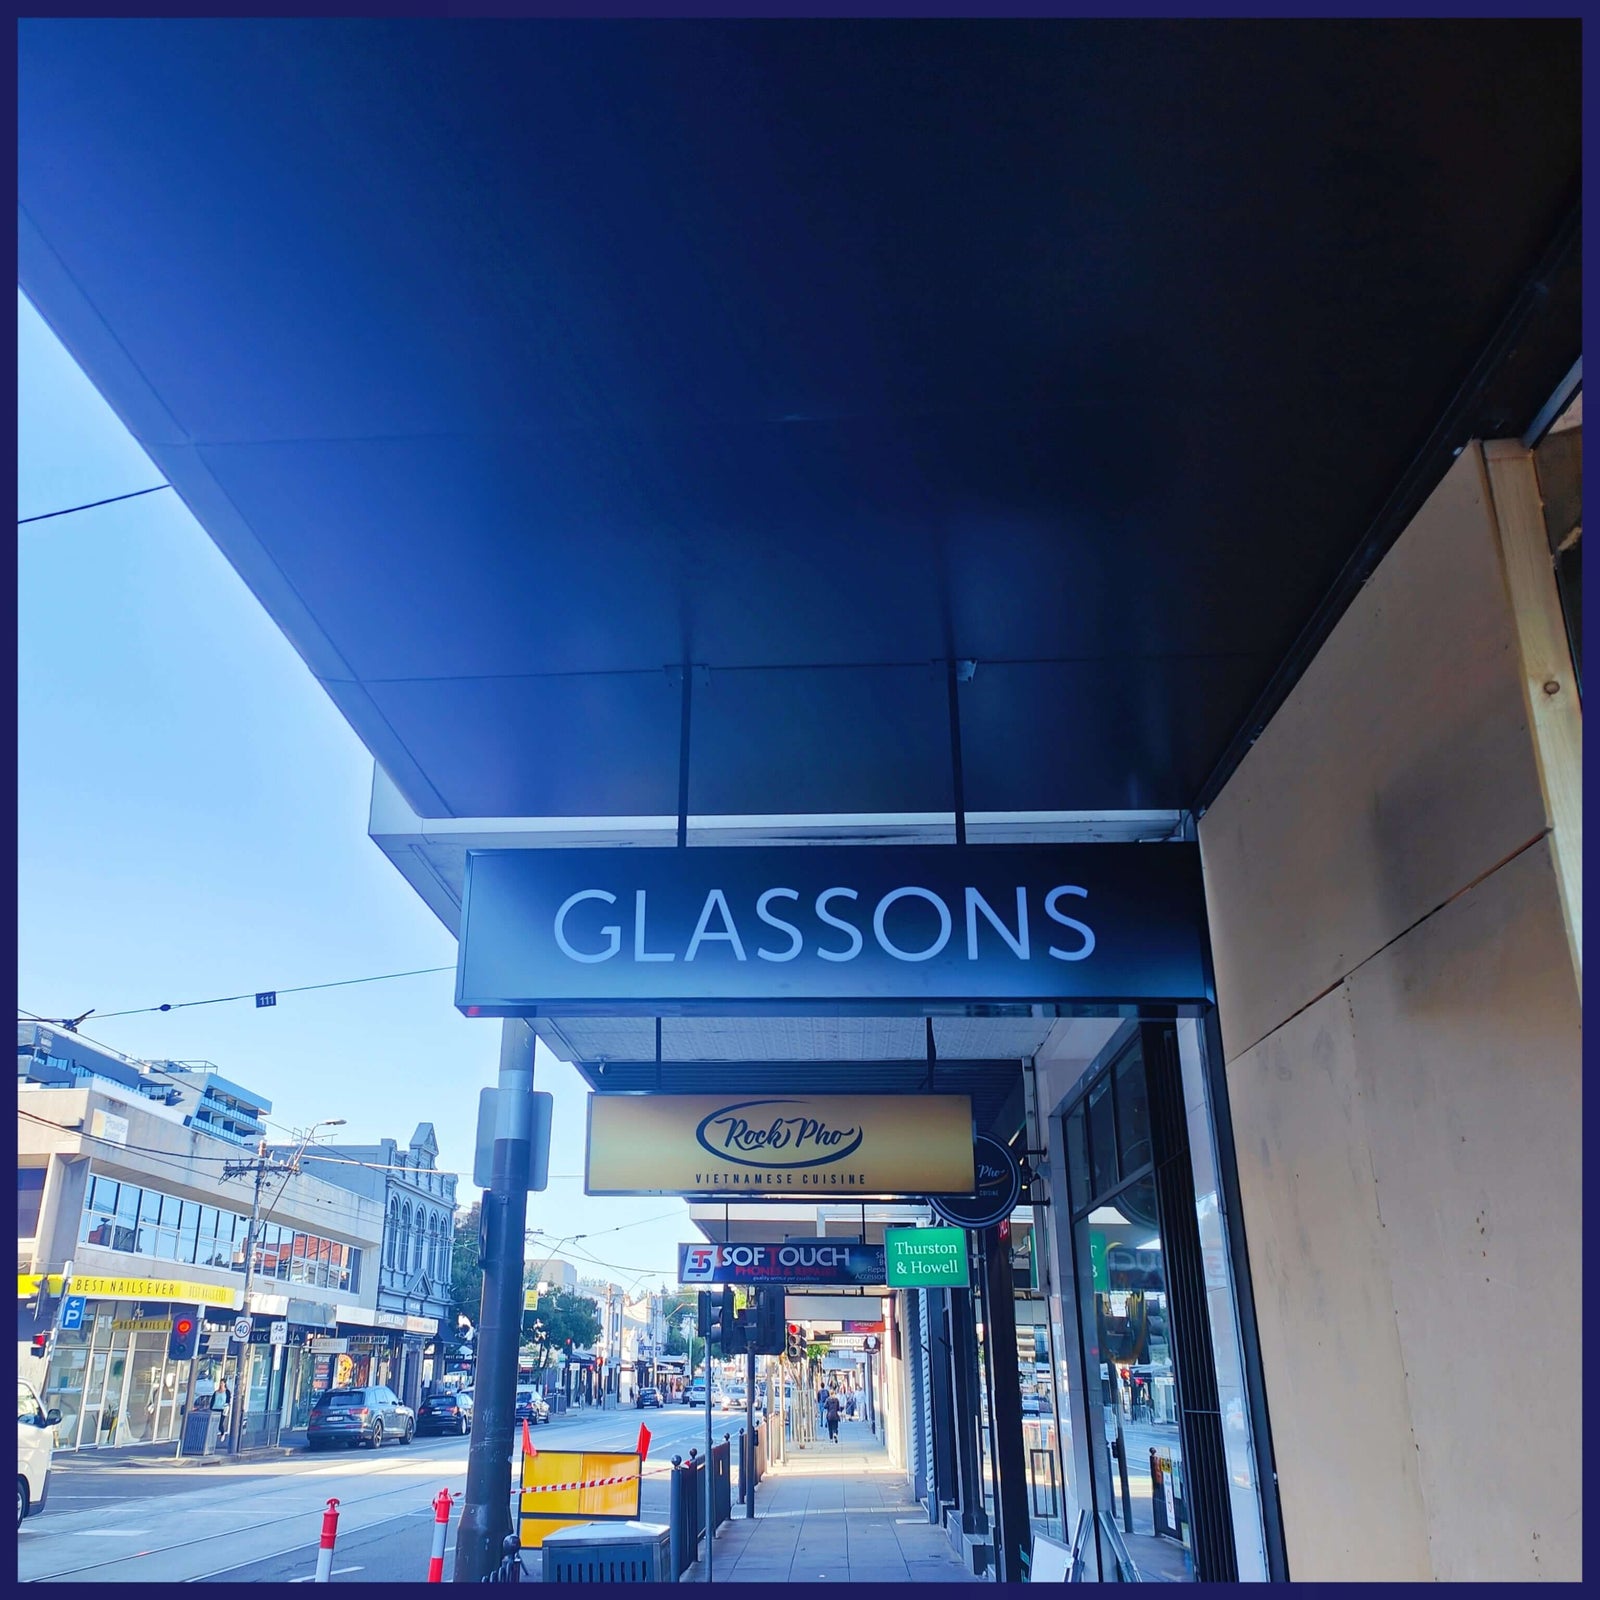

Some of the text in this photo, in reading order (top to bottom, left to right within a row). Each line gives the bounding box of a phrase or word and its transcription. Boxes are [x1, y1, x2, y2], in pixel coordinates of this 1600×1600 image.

[553, 884, 1096, 964] GLASSONS
[714, 1117, 855, 1151] Rock Pho
[695, 1173, 865, 1185] VIETNAMESE CUISINE
[894, 1241, 958, 1255] Thurston
[896, 1261, 907, 1274] &
[911, 1260, 959, 1274] Howell
[76, 1279, 105, 1292] BEST
[64, 1309, 80, 1326] P
[236, 1325, 248, 1334] 40
